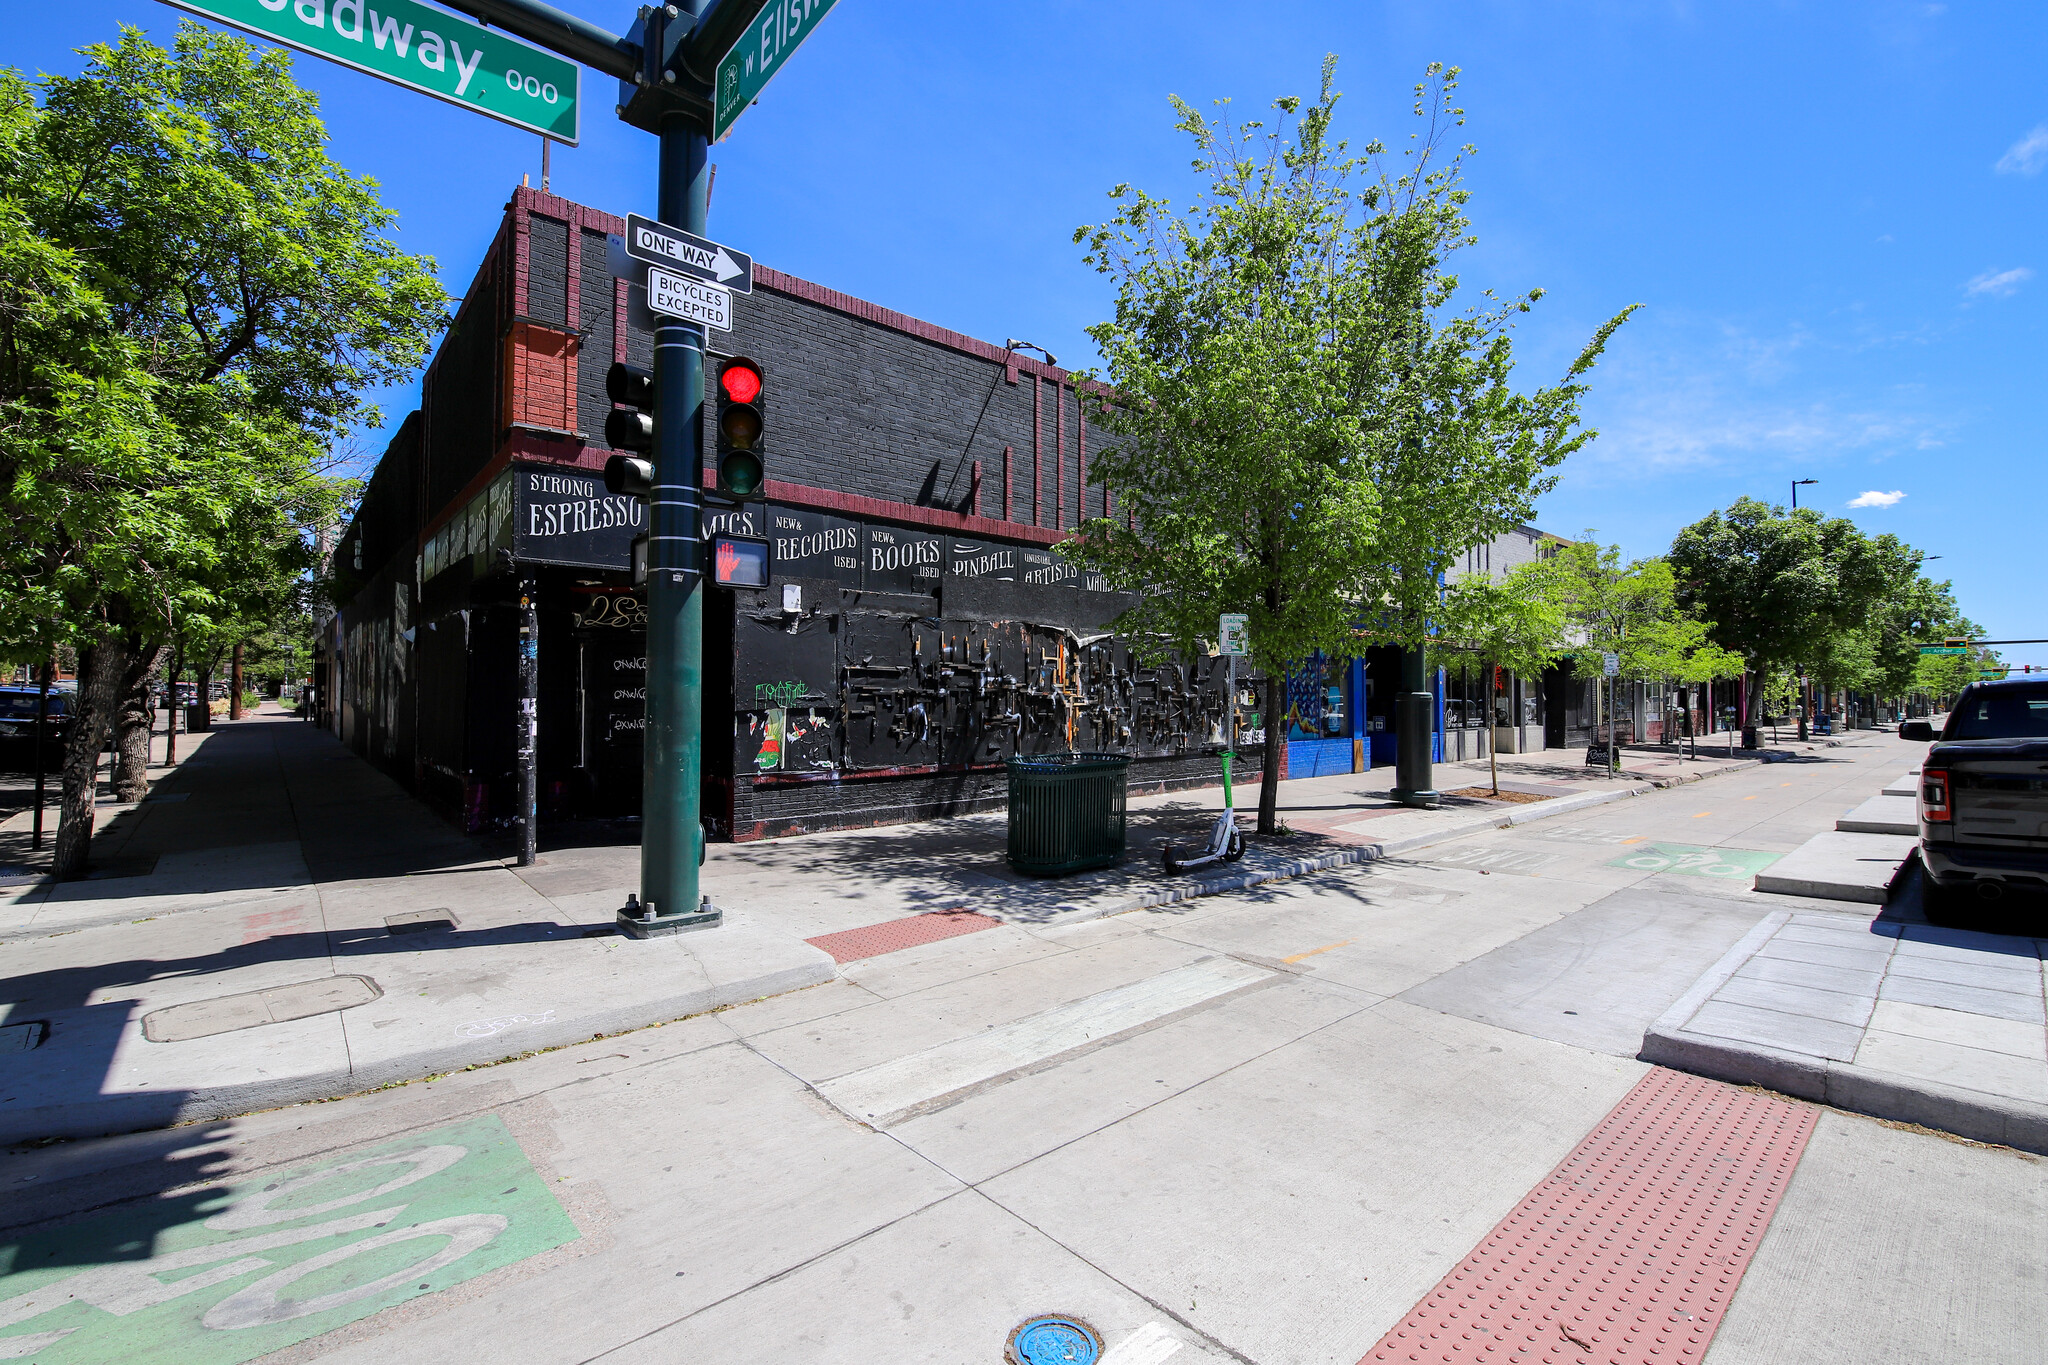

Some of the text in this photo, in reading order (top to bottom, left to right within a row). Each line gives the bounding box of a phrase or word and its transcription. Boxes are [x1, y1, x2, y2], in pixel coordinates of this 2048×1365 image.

[257, 0, 484, 96] adway
[745, 50, 755, 78] W
[719, 93, 741, 122] DENVER
[641, 231, 716, 269] ONE WAY
[659, 276, 722, 307] BICYCLES
[657, 293, 724, 323] EXCEPTED
[530, 473, 594, 498] STRONG
[529, 496, 642, 537] ESPRESSO
[702, 511, 754, 541] MICS
[776, 526, 857, 561] RECORDS
[871, 540, 940, 572] BOOKS
[833, 555, 857, 569] USED
[919, 565, 940, 578] USED
[952, 550, 1015, 577] PINBALL
[1025, 560, 1078, 585] ARTISTS
